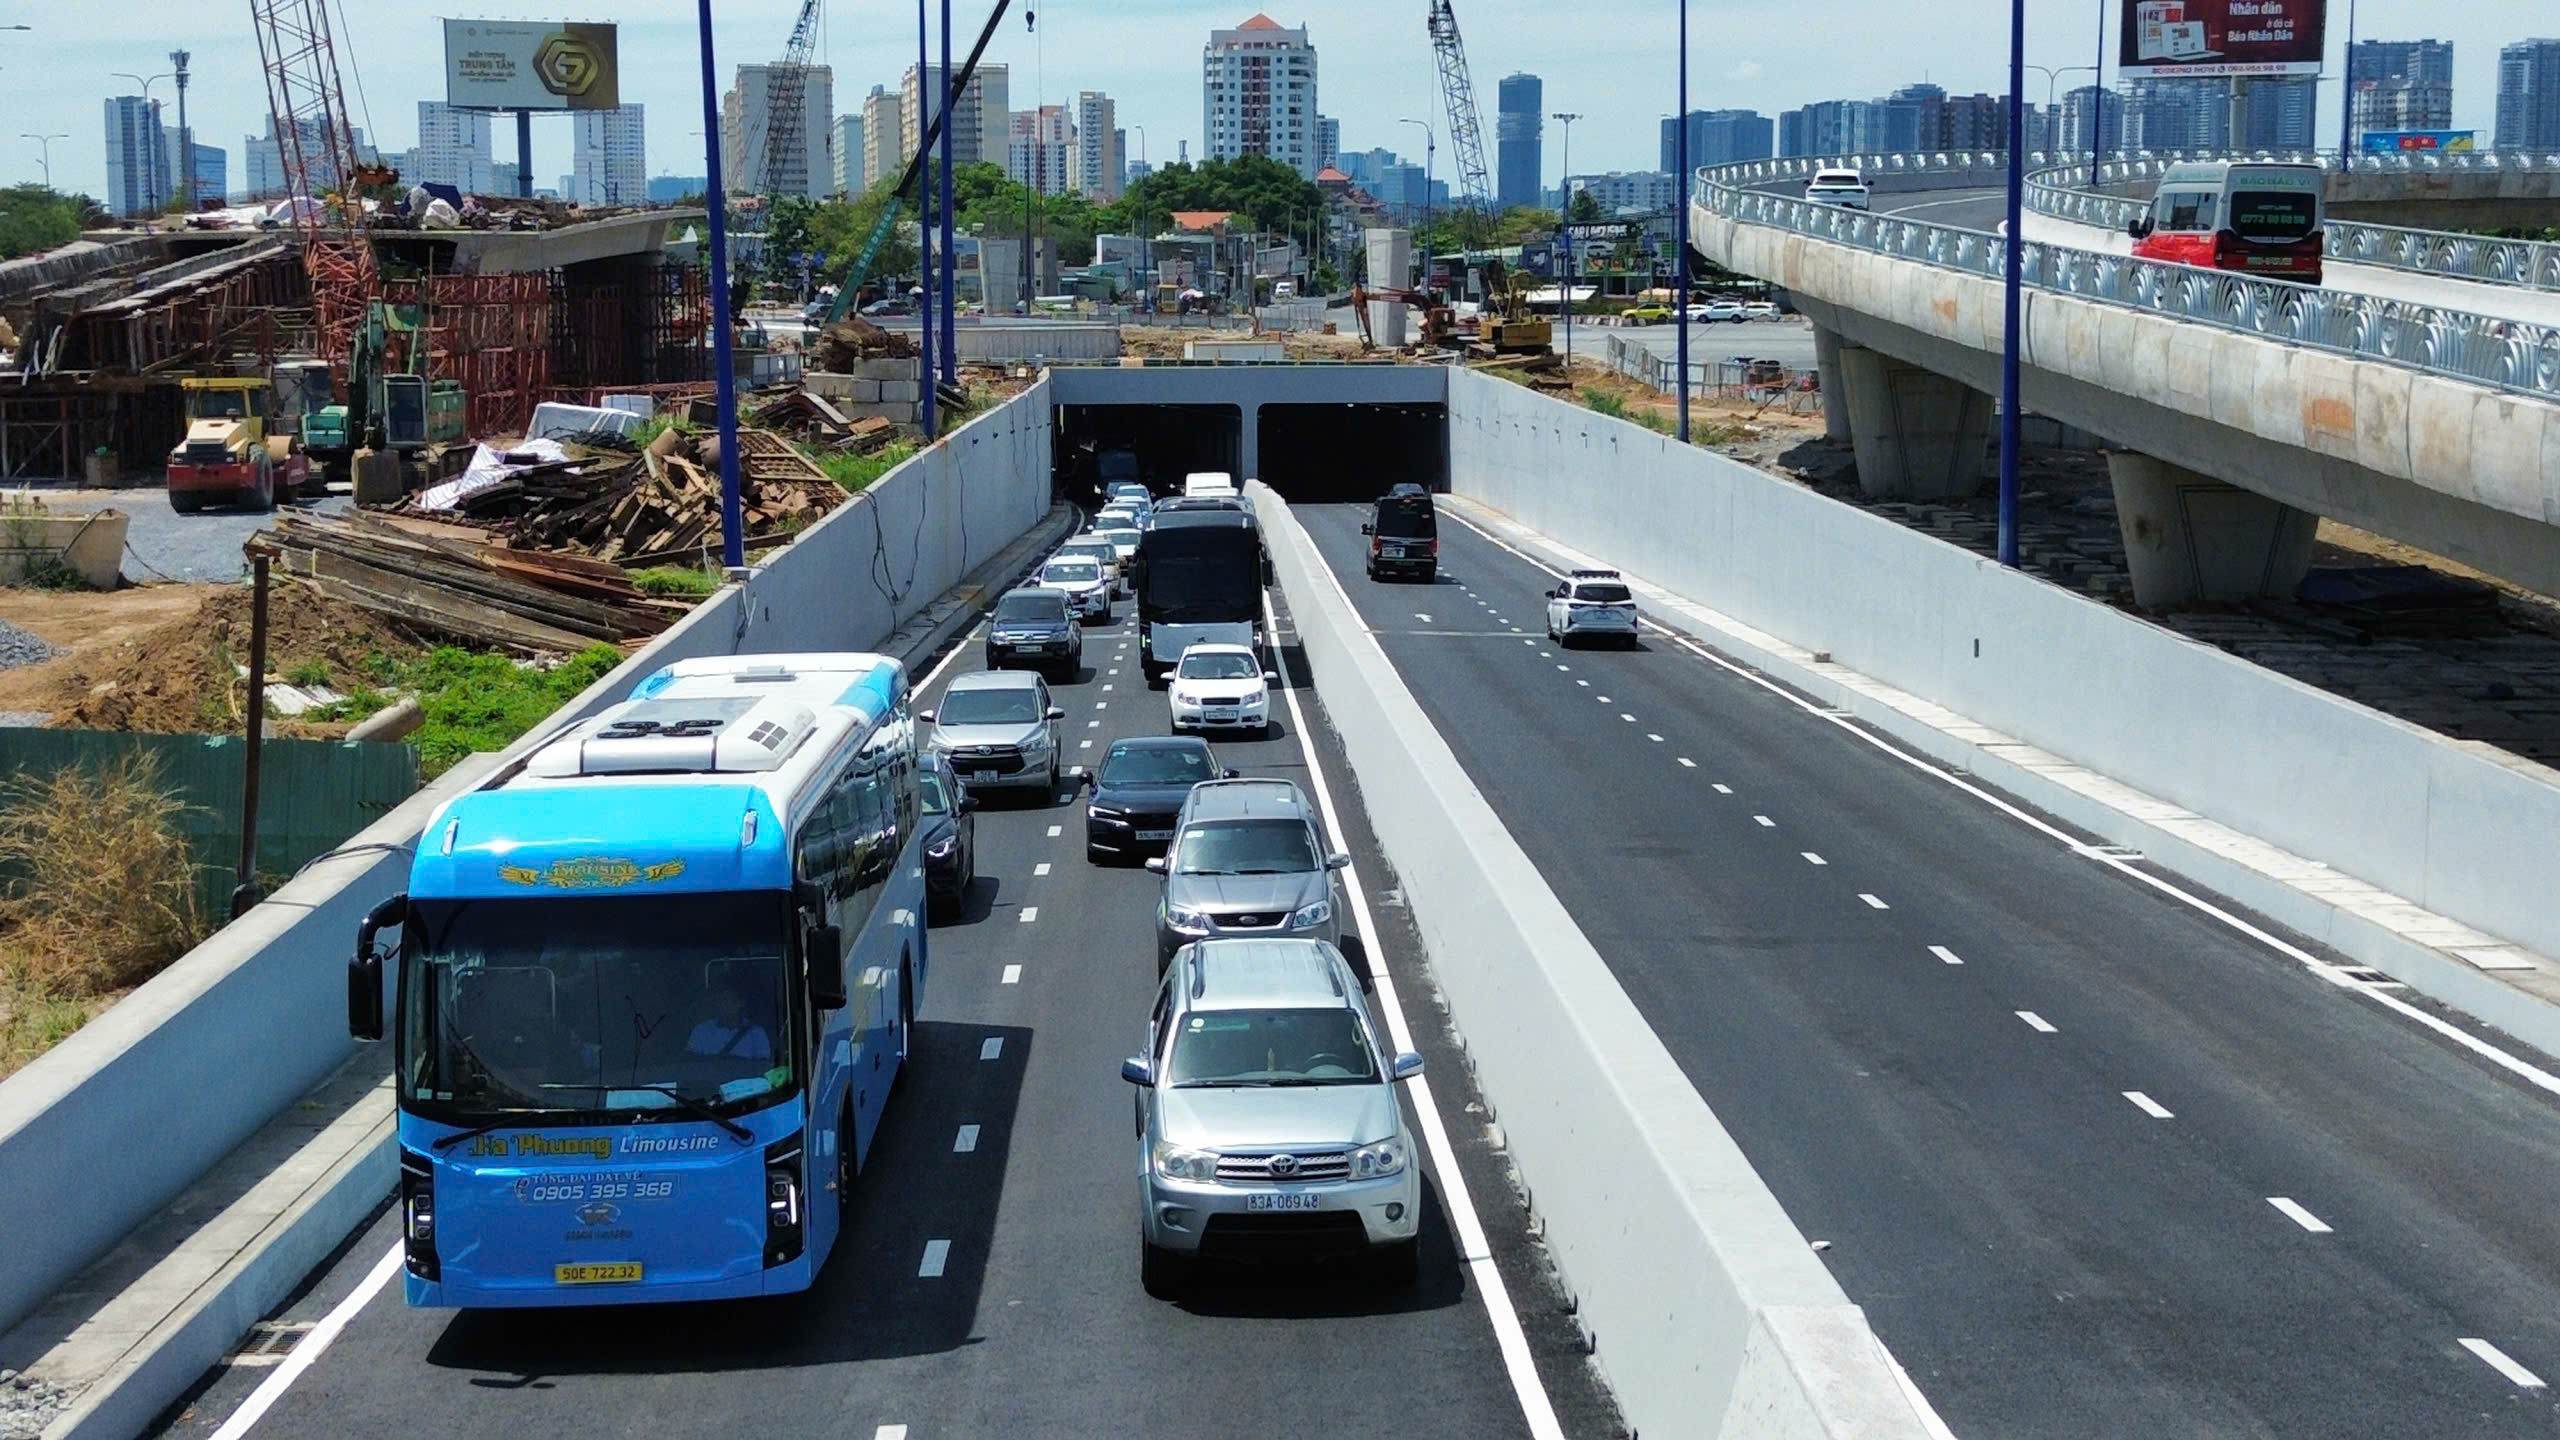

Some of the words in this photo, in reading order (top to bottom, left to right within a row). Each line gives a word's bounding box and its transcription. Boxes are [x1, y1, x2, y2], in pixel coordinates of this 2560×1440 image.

[619, 1133, 720, 1153] Limousine
[533, 1185, 584, 1201] 0905
[589, 1184, 628, 1199] 395
[633, 1182, 673, 1197] 368
